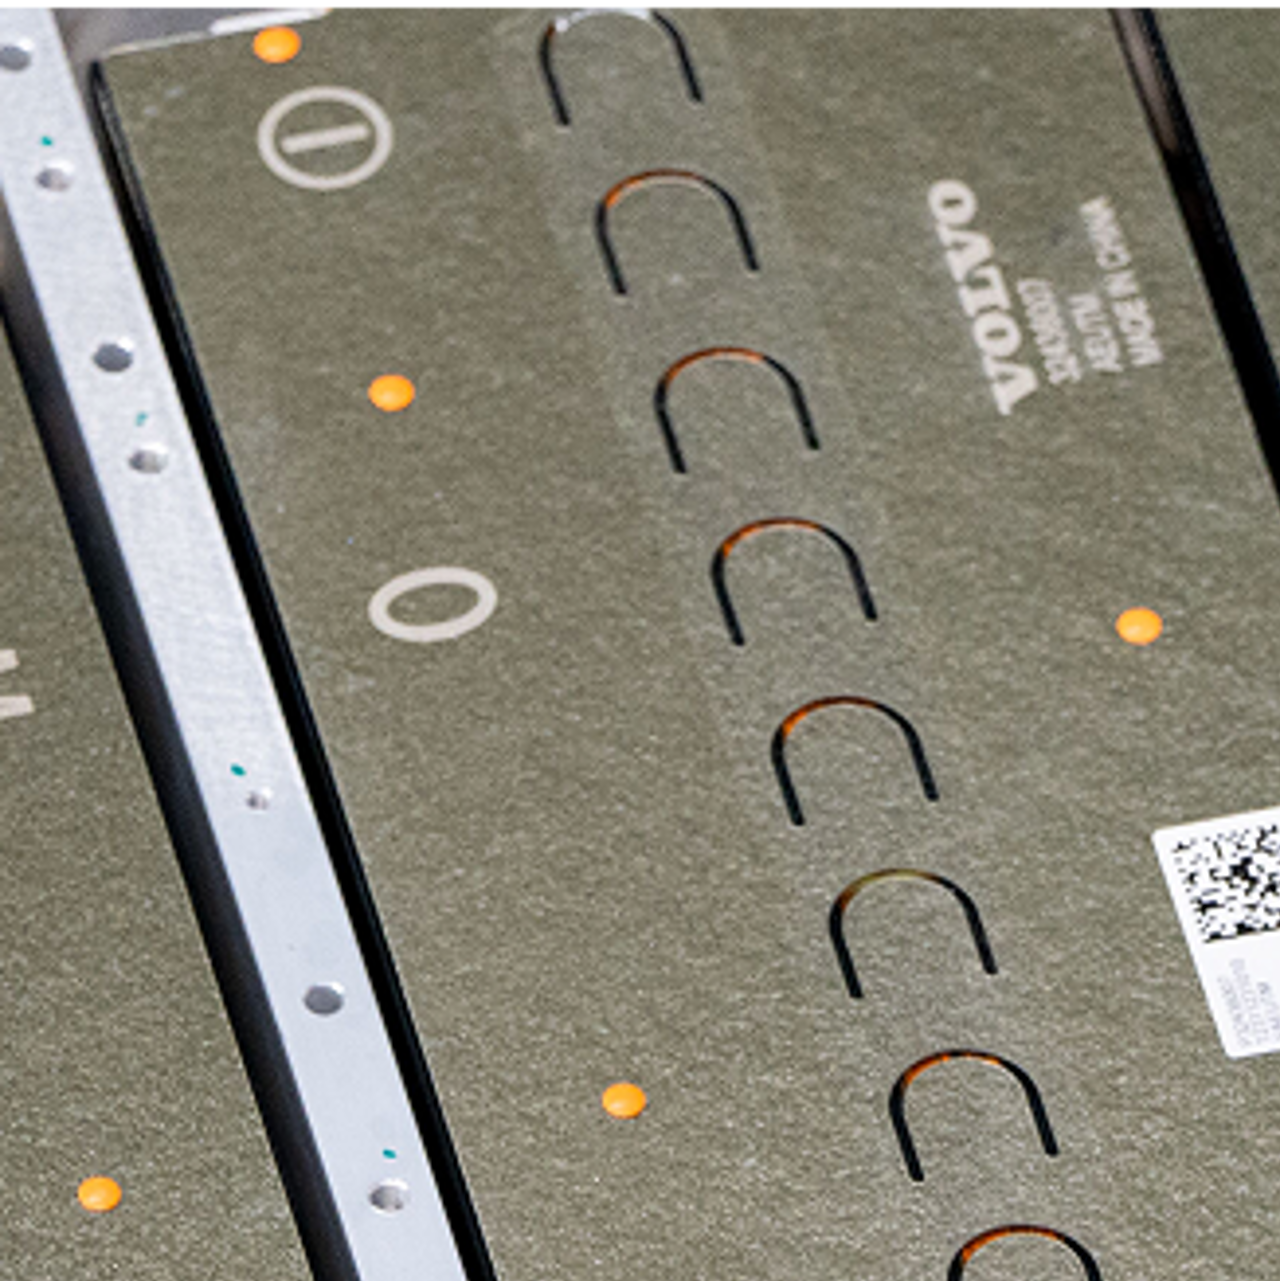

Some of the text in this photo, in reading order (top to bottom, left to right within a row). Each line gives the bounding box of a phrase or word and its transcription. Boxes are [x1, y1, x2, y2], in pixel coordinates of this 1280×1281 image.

[928, 180, 1037, 415] VOLVO
[1079, 194, 1165, 367] MADE IN CHINA
